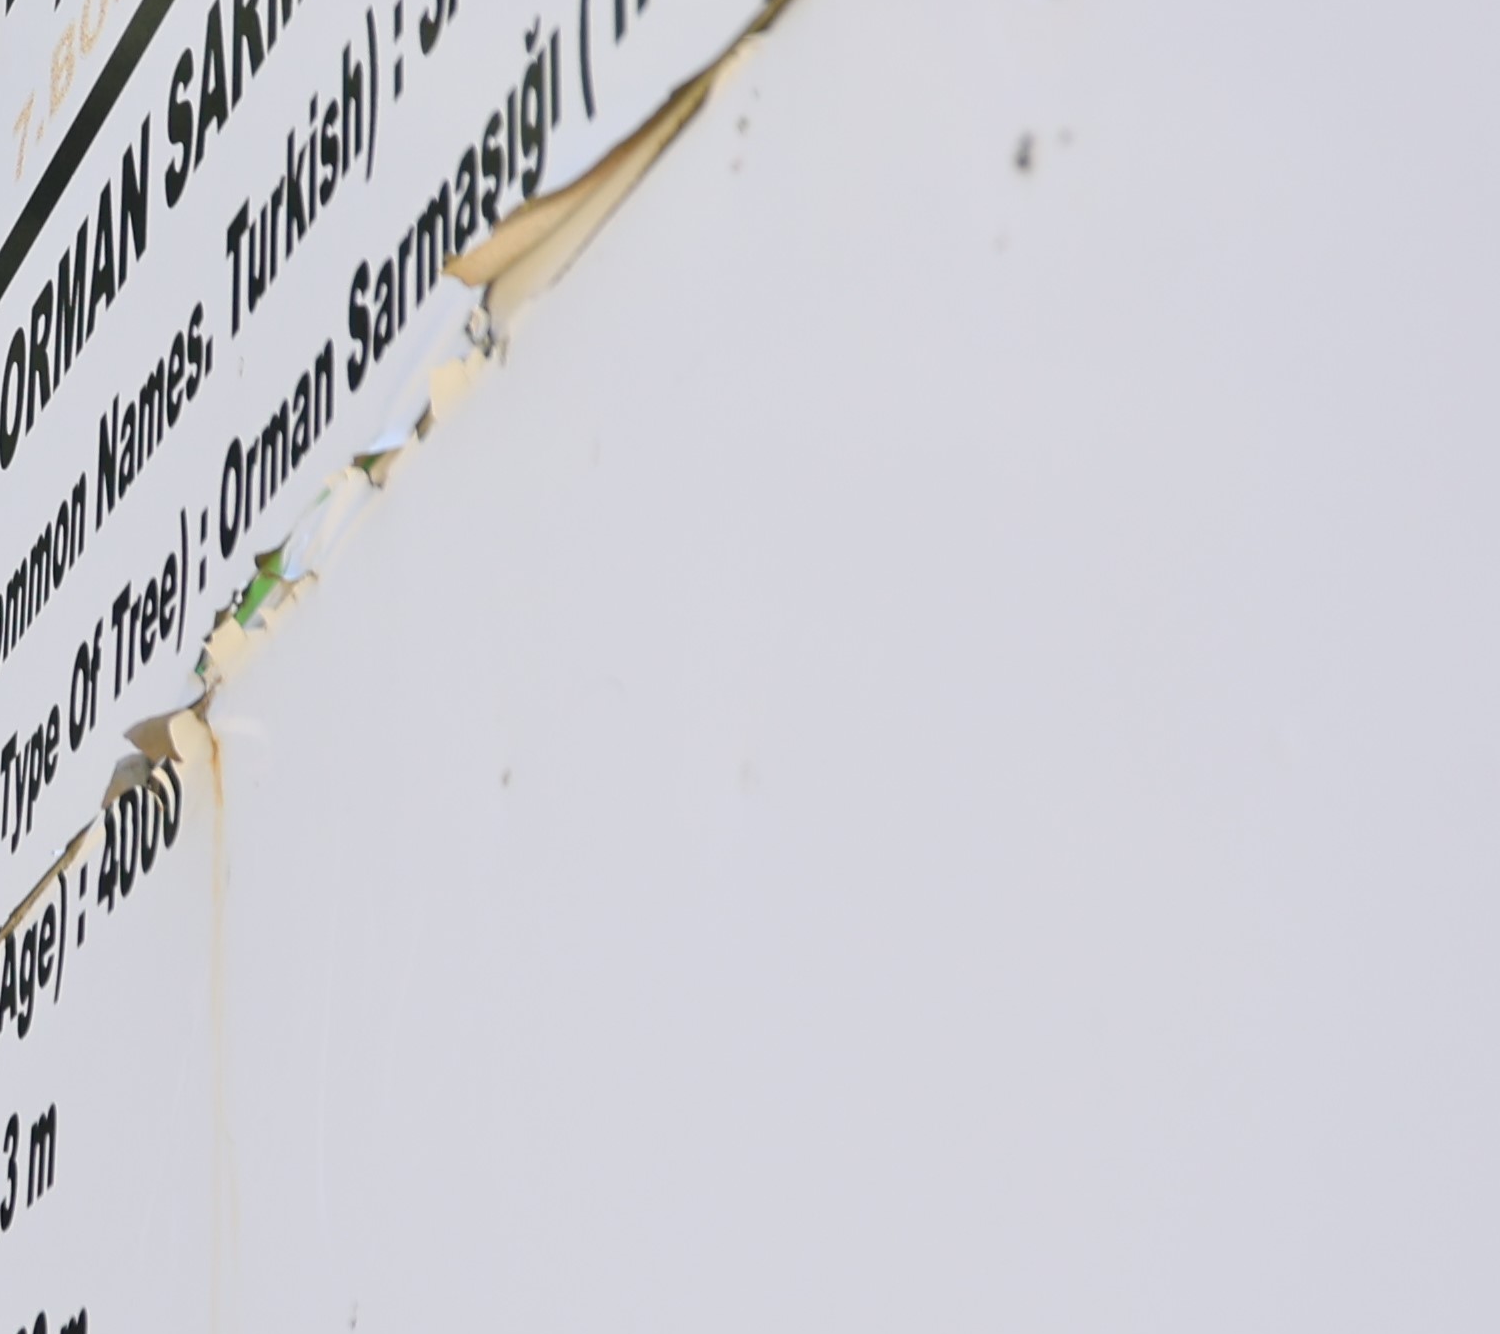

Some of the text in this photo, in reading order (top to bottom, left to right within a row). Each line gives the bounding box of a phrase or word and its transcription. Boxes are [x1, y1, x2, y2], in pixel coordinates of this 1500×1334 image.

[0, 113, 151, 470] ORMAN
[226, 5, 378, 338] Turkish)
[0, 703, 61, 855] Type
[69, 616, 103, 753] Of
[111, 506, 189, 702] Tree)
[219, 338, 334, 560] Orman
[348, 14, 560, 393] Sarmaşığı
[26, 1101, 58, 1209] m
